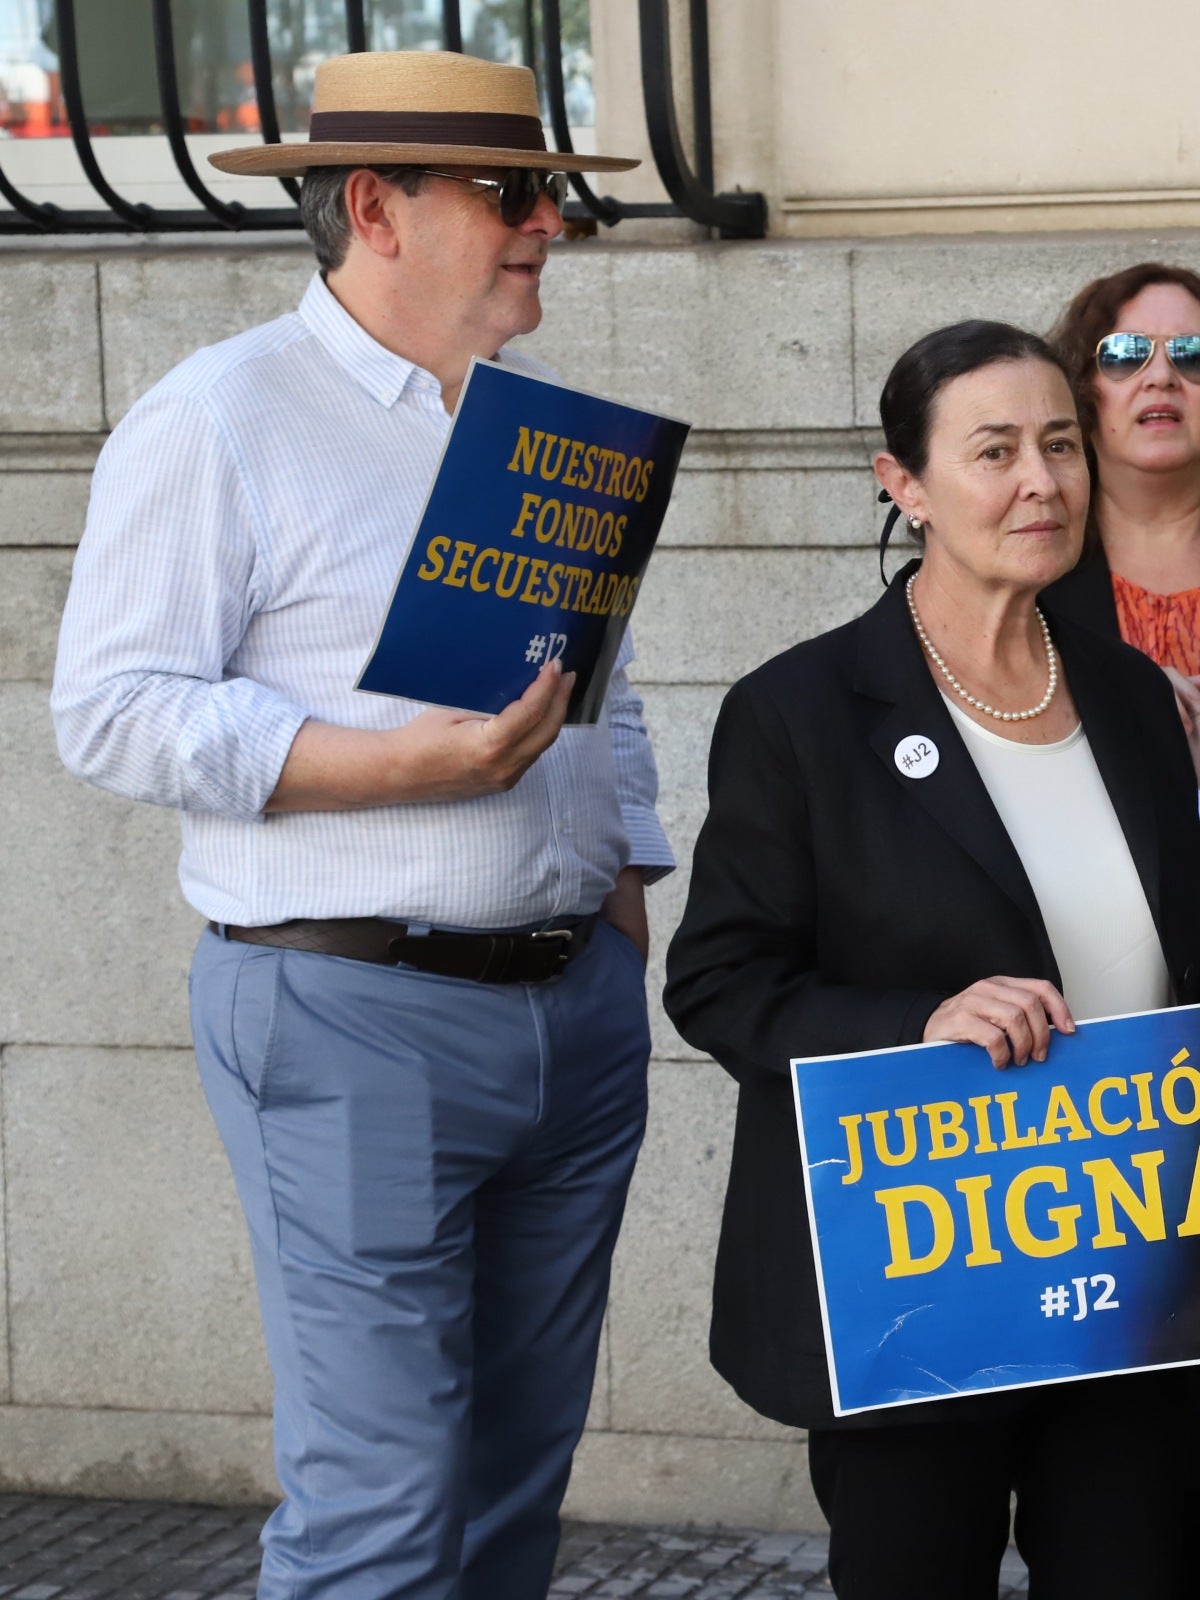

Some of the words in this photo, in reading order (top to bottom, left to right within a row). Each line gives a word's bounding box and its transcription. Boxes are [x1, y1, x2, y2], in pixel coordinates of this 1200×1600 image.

[507, 426, 654, 503] NUESTROS
[511, 493, 628, 557] FONDOS
[417, 535, 639, 617] SECUESTRADOS
[902, 742, 932, 770] #J2
[1040, 1273, 1120, 1322] #J2
